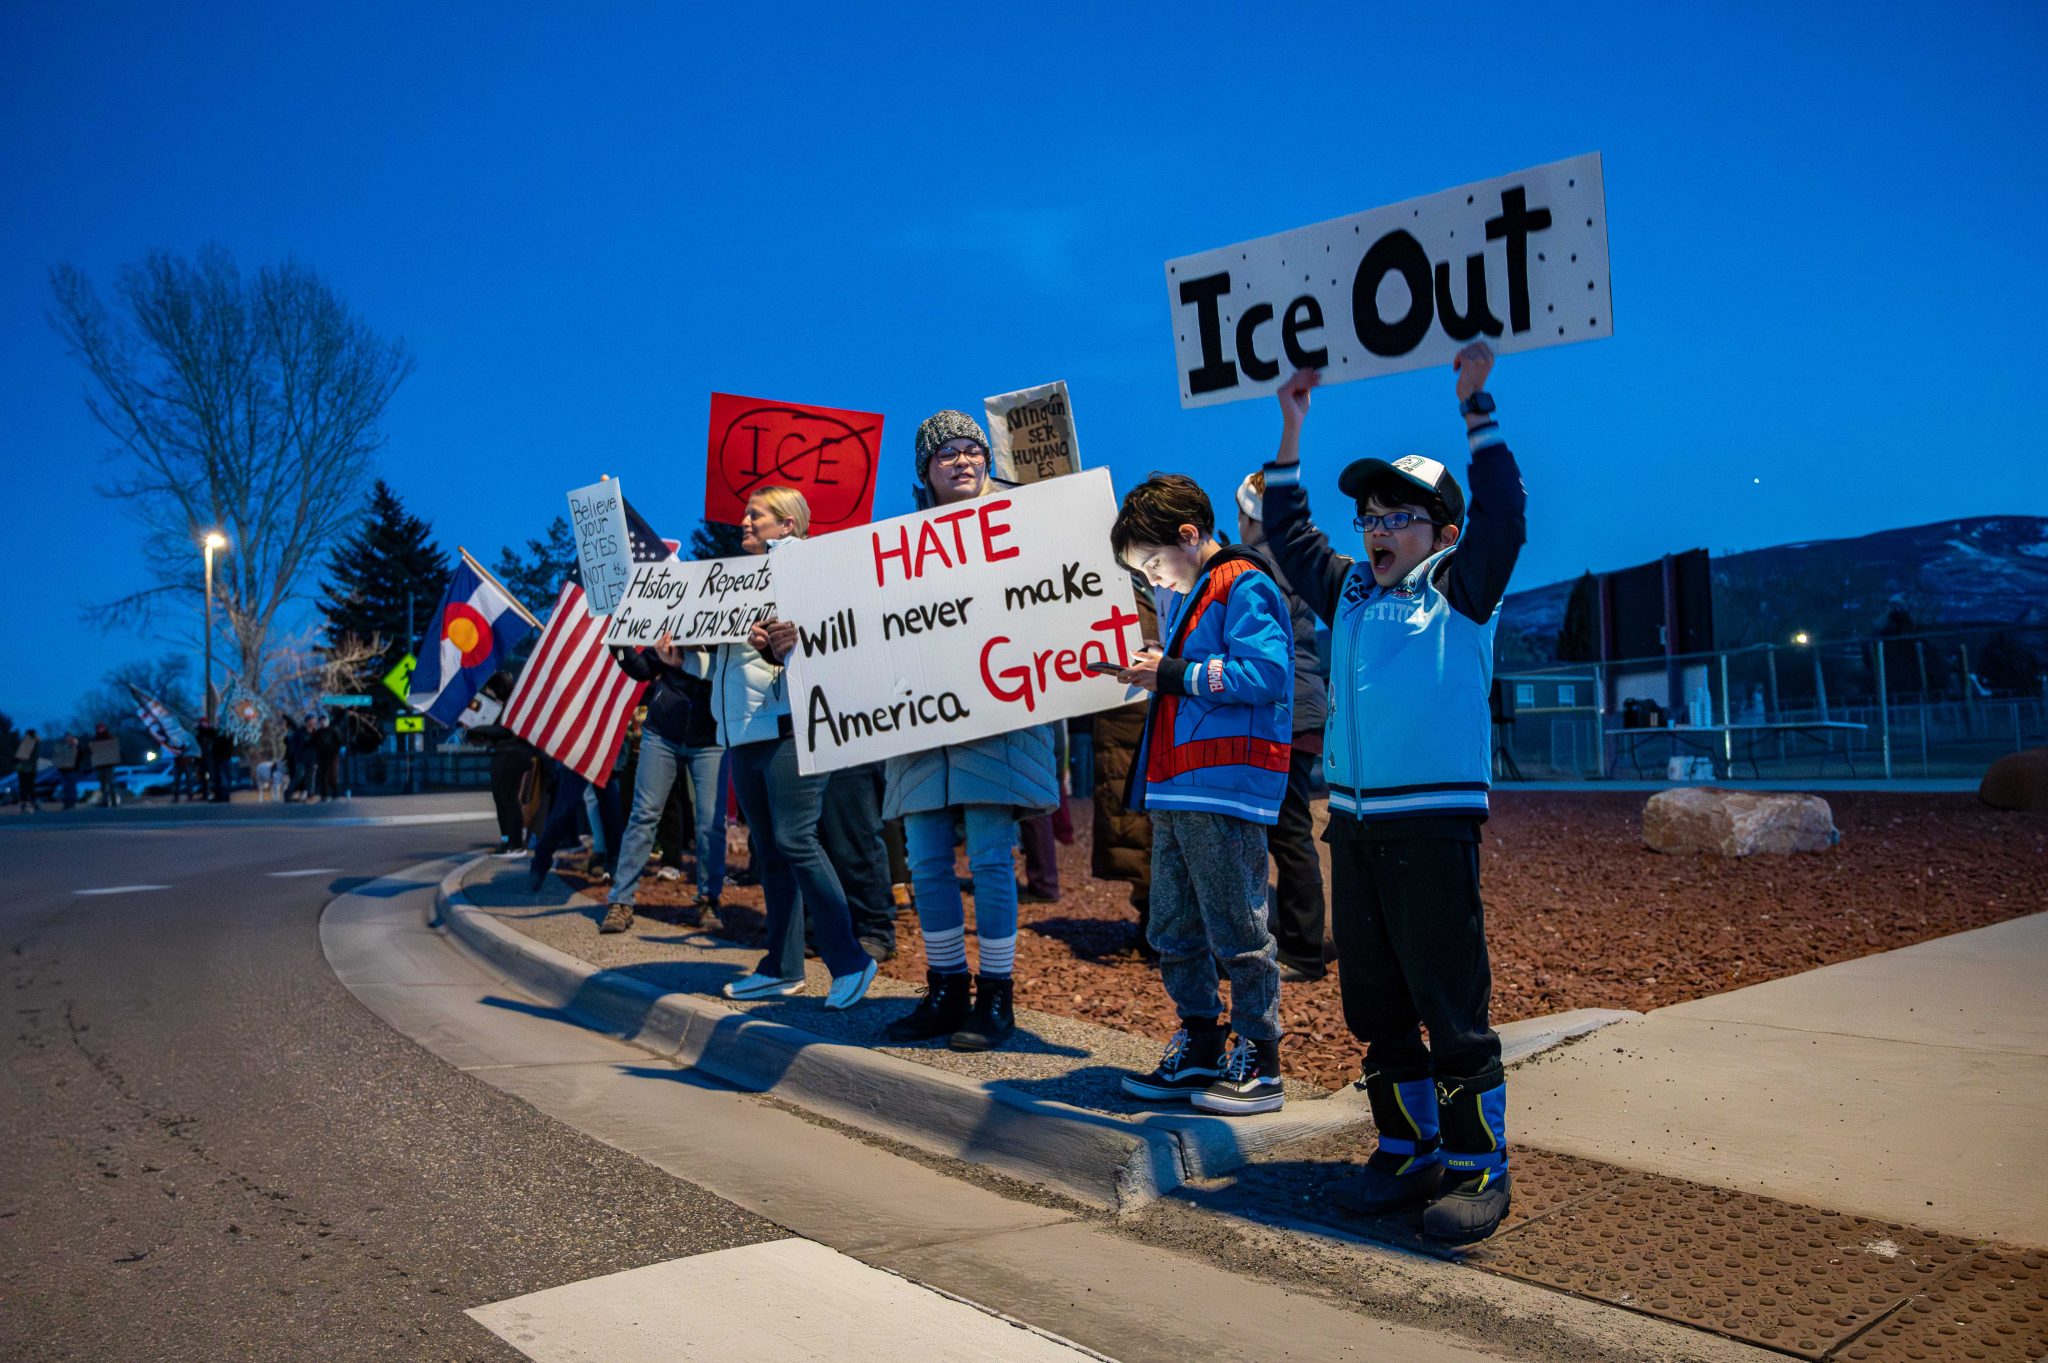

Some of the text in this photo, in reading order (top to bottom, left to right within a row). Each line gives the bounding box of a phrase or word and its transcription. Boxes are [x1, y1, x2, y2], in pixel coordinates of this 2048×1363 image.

[1180, 185, 1552, 395] Ice Out
[1028, 424, 1058, 444] SER
[740, 425, 841, 485] ICE
[1012, 441, 1070, 465] HUMANO
[1037, 461, 1056, 478] ES
[570, 496, 617, 526] Believe
[580, 518, 609, 545] your
[872, 499, 1020, 588] HATE
[582, 535, 618, 563] EYES
[583, 563, 607, 588] NOT
[627, 559, 773, 610] History Repeats
[592, 581, 626, 611] LIES
[608, 606, 632, 640] if
[628, 617, 652, 640] we
[653, 612, 685, 641] ALL
[686, 610, 729, 639] STAY
[883, 597, 974, 641] never
[1363, 602, 1417, 622] STITC
[807, 605, 1139, 753] America Great
[1207, 660, 1225, 693] MARVEL
[1448, 1159, 1476, 1167] SOREL
